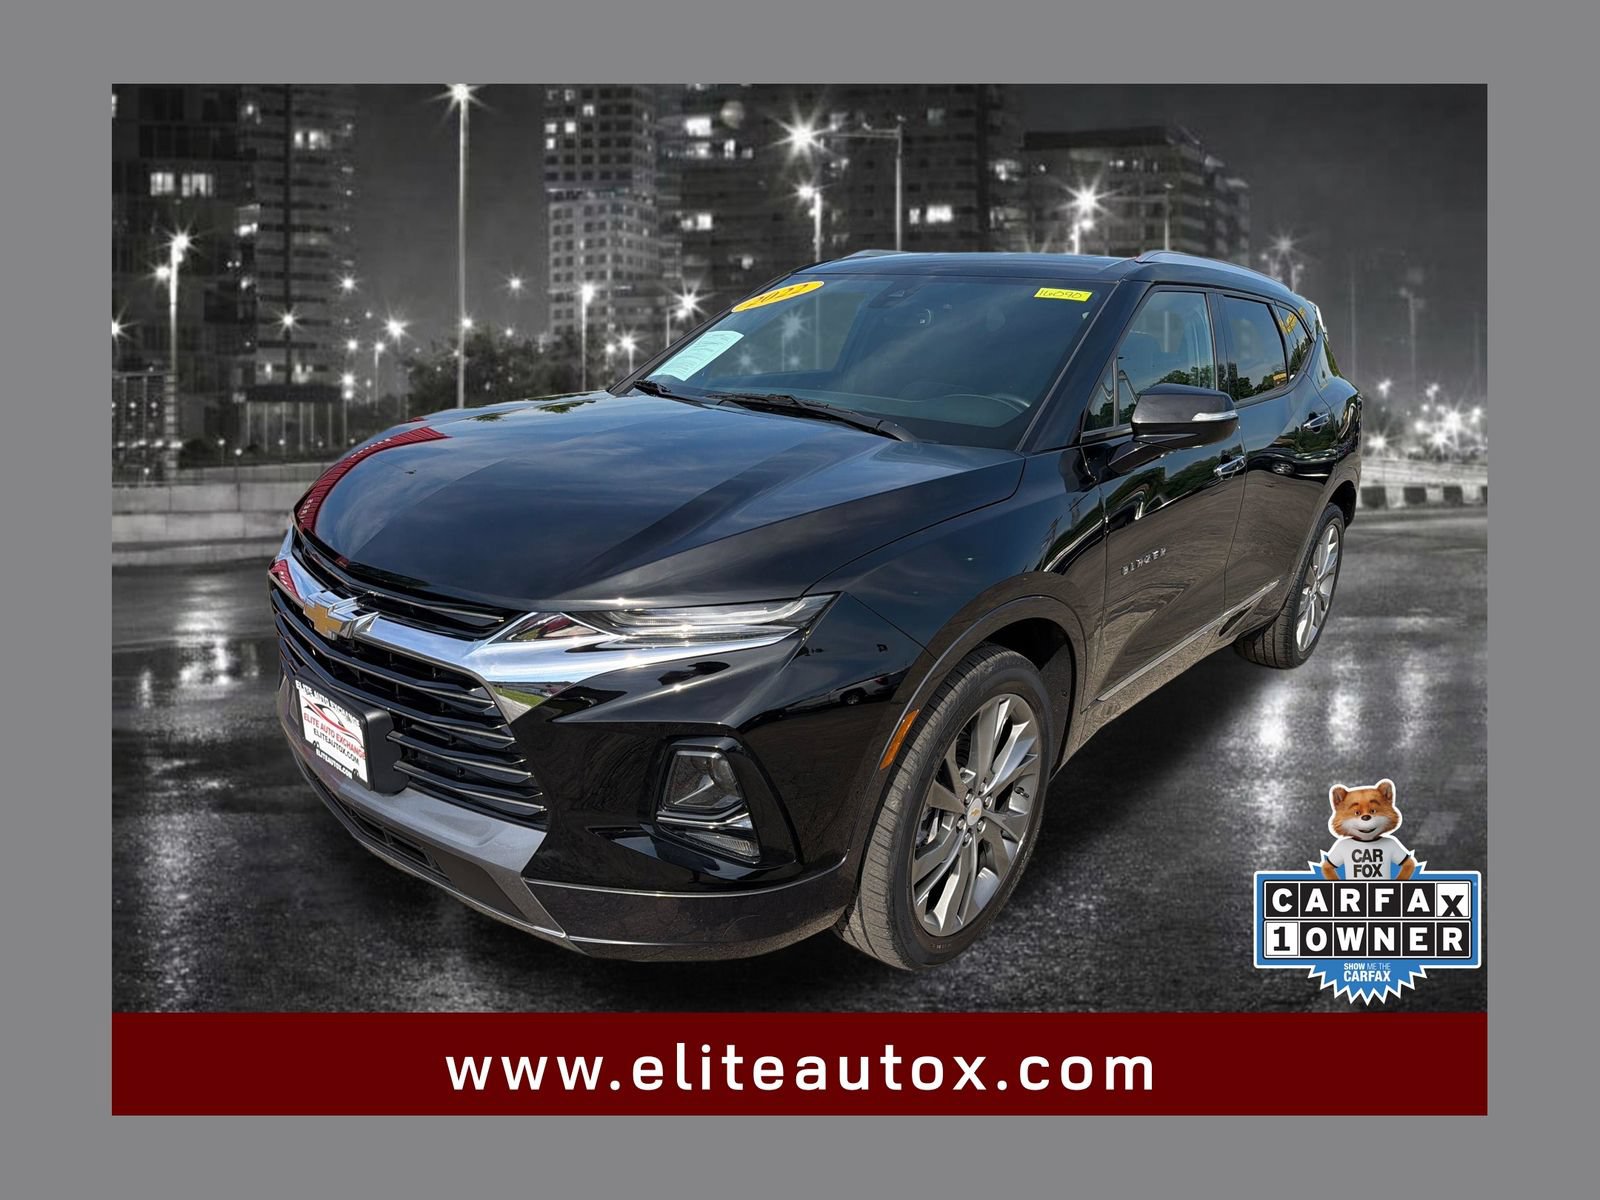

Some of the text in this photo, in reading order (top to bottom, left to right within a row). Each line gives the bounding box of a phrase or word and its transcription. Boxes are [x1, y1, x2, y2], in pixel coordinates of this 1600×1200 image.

[1121, 547, 1167, 576] BLAZER
[303, 712, 367, 759] ELITE AUTO EXCHANG
[313, 728, 360, 764] ELITEAUTOX.COM
